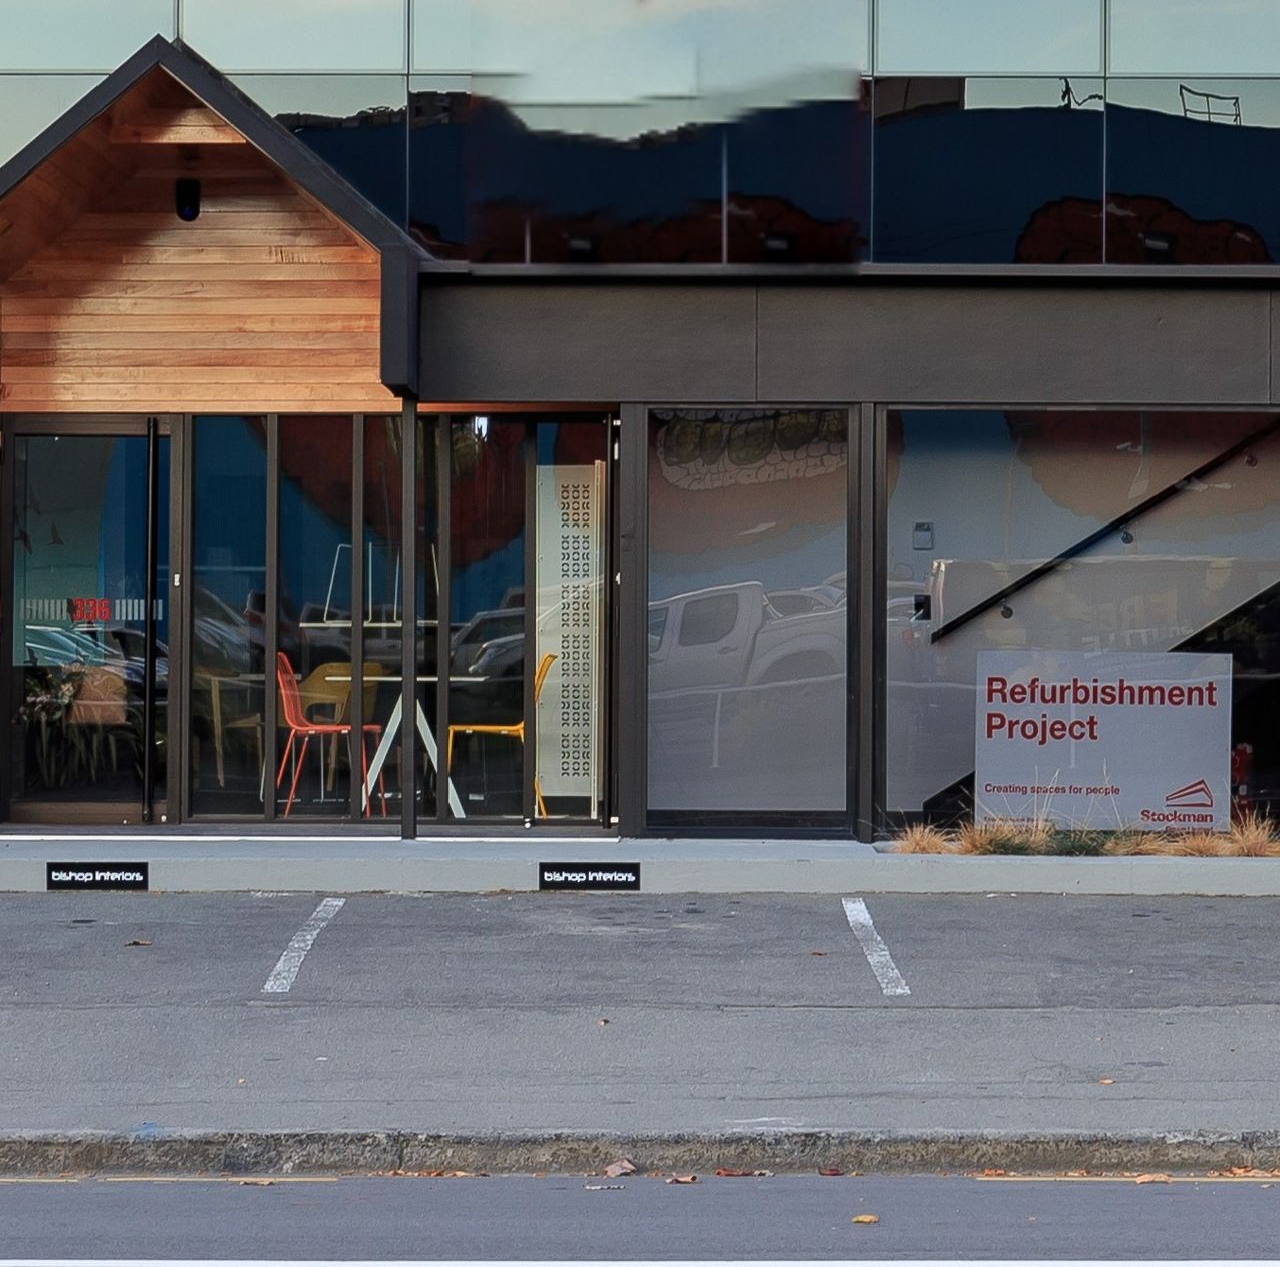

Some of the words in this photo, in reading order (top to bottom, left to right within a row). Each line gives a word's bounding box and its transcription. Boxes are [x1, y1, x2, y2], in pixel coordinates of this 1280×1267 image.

[73, 597, 111, 621] 336
[986, 676, 1218, 706] Refurbishment
[985, 712, 1099, 746] Project
[984, 783, 1028, 796] Creating
[1030, 785, 1066, 796] spaces
[1069, 784, 1084, 795] for
[1086, 784, 1120, 796] people
[1140, 809, 1214, 823] Stockman
[51, 870, 93, 882] bishop
[543, 871, 587, 883] bishop
